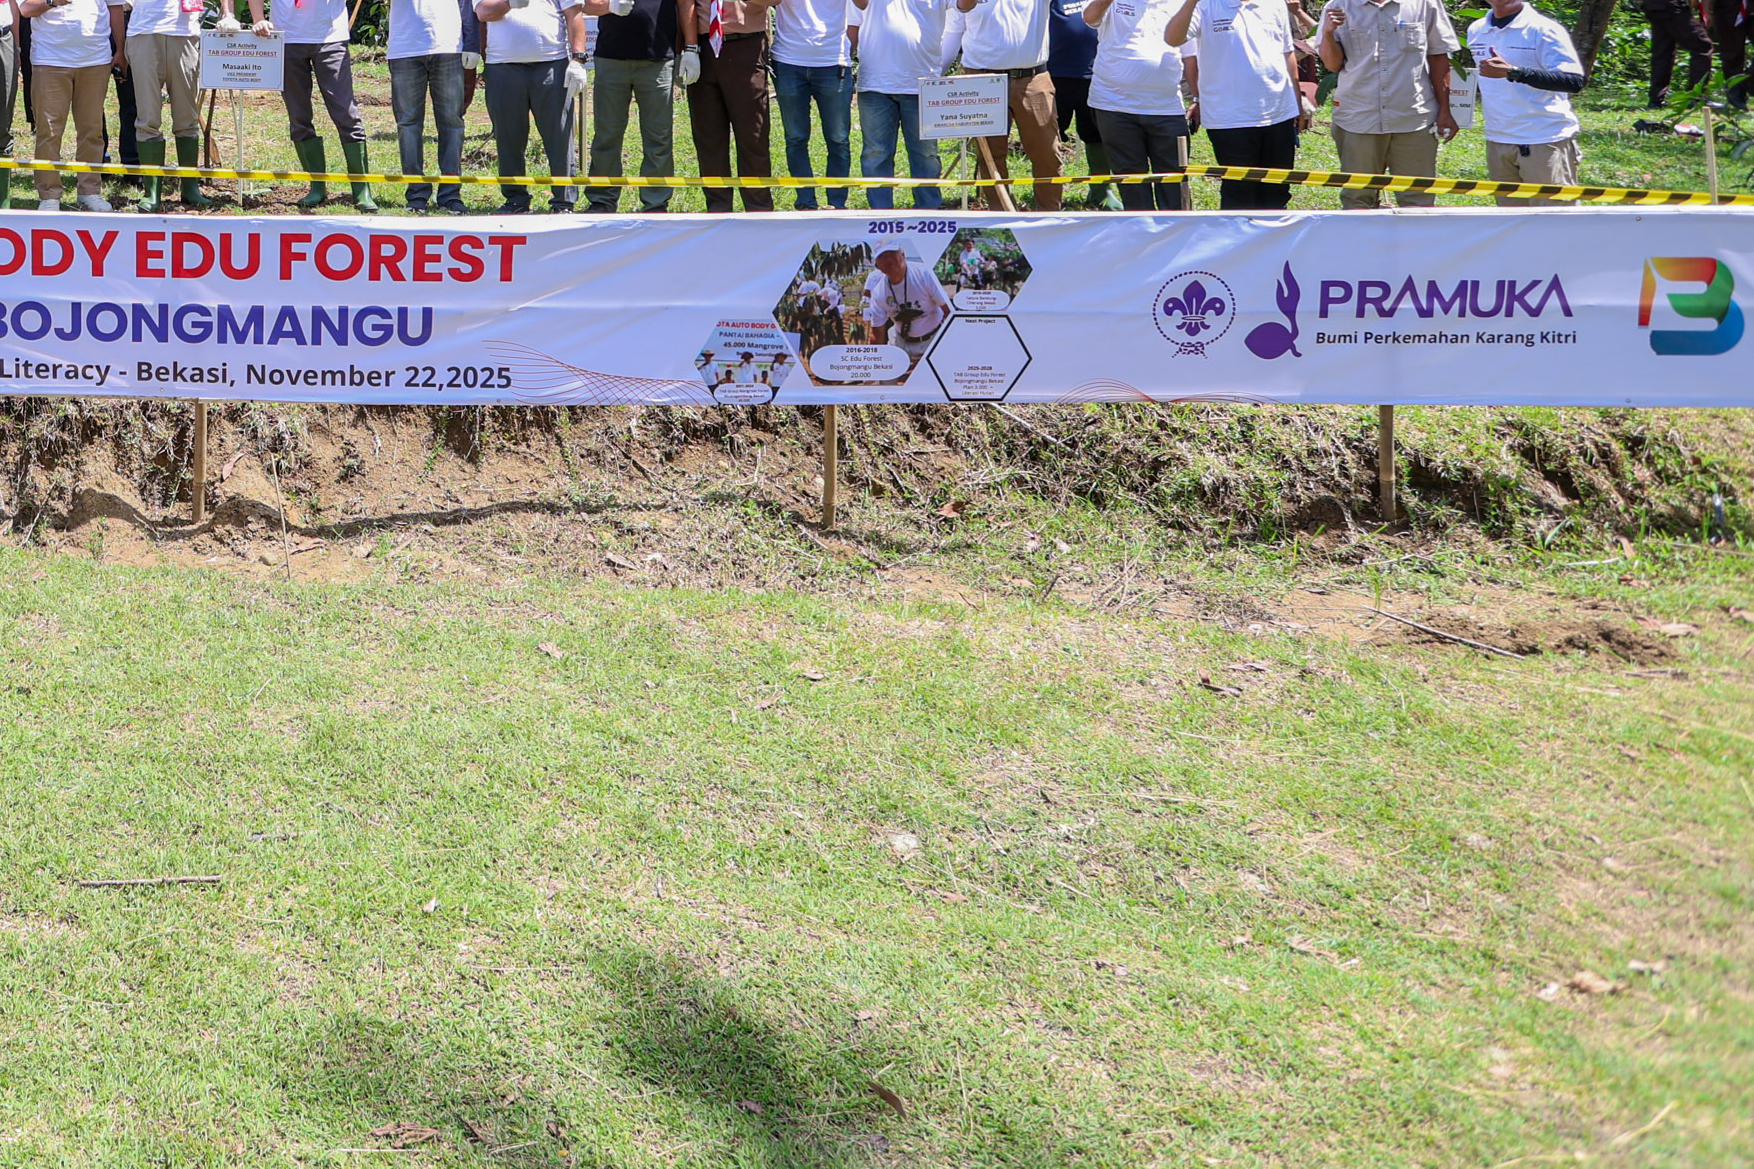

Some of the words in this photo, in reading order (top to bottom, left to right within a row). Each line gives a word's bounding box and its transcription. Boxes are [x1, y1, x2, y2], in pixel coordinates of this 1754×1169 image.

[868, 221, 904, 234] 2015
[135, 231, 260, 280] EDU
[279, 233, 527, 282] FOREST
[1319, 273, 1574, 318] PRAMUKA
[747, 342, 783, 351] Mangrove
[1316, 331, 1358, 344] Bumi
[1364, 331, 1470, 344] Perkemahan
[1476, 331, 1534, 348] Karang
[1540, 331, 1577, 344] Kitri
[137, 360, 236, 386] Bekasi,
[246, 364, 396, 388] November
[404, 366, 512, 390] 22,2025
